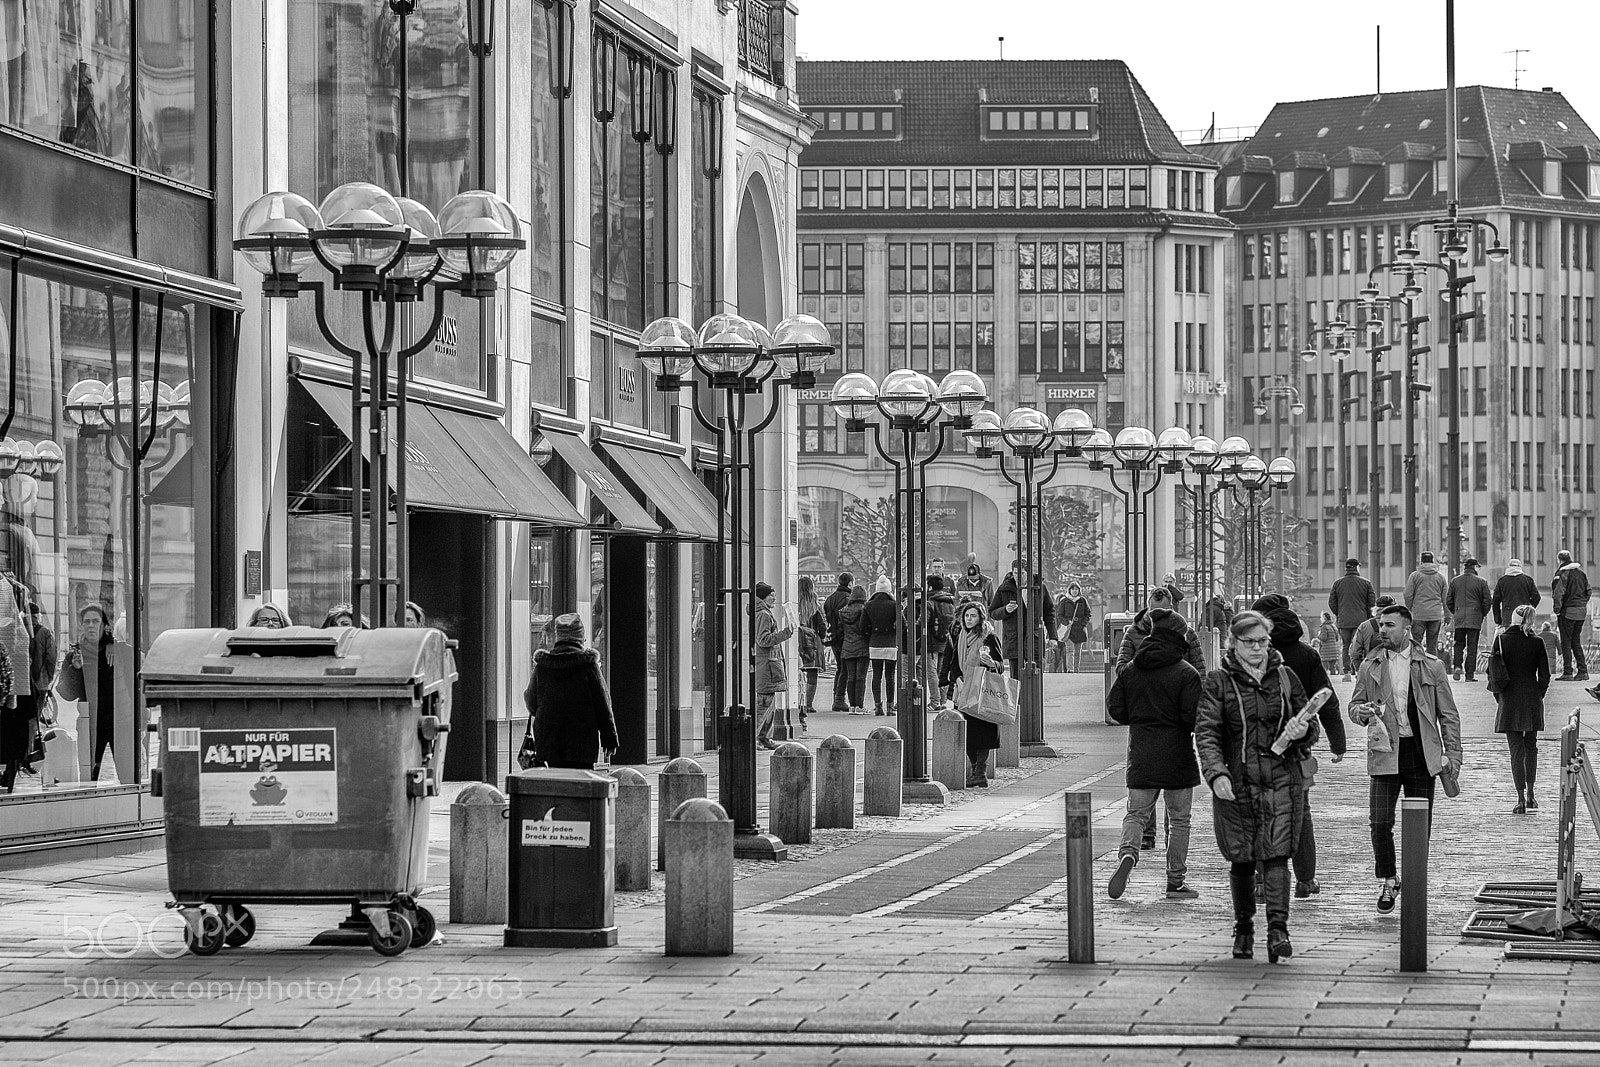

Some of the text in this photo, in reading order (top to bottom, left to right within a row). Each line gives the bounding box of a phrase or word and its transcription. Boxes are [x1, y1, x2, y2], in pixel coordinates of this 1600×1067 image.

[1047, 388, 1096, 399] HIRMER
[245, 731, 290, 742] NUR FÜR
